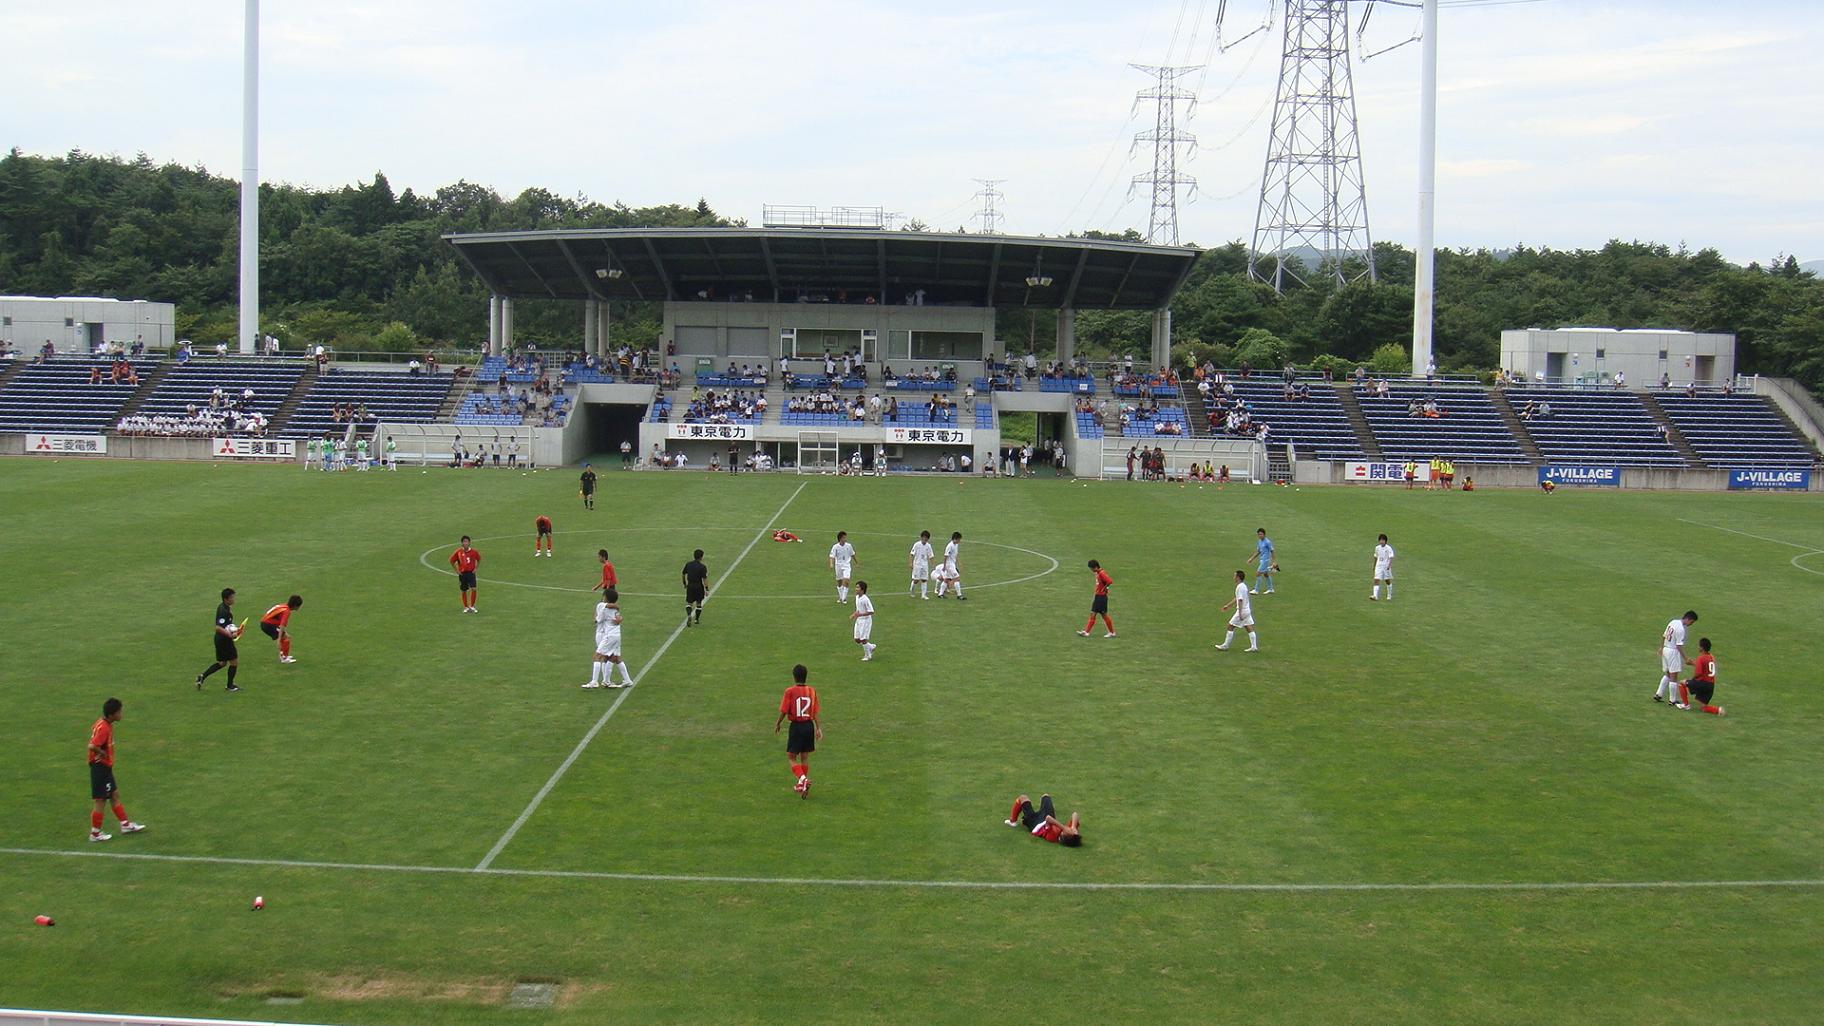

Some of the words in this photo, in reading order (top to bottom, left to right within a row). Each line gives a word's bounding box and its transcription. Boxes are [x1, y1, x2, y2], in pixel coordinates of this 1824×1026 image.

[690, 425, 746, 438] 東京電力
[908, 429, 964, 442] 東京電力
[52, 439, 97, 451] 三菱電機
[237, 441, 292, 455] 三菱重工
[1370, 463, 1419, 479] 関電
[1546, 468, 1614, 479] J-VILLAGE
[1736, 471, 1803, 482] J-VILLAGE
[1707, 661, 1716, 677] 9
[795, 696, 812, 717] 12
